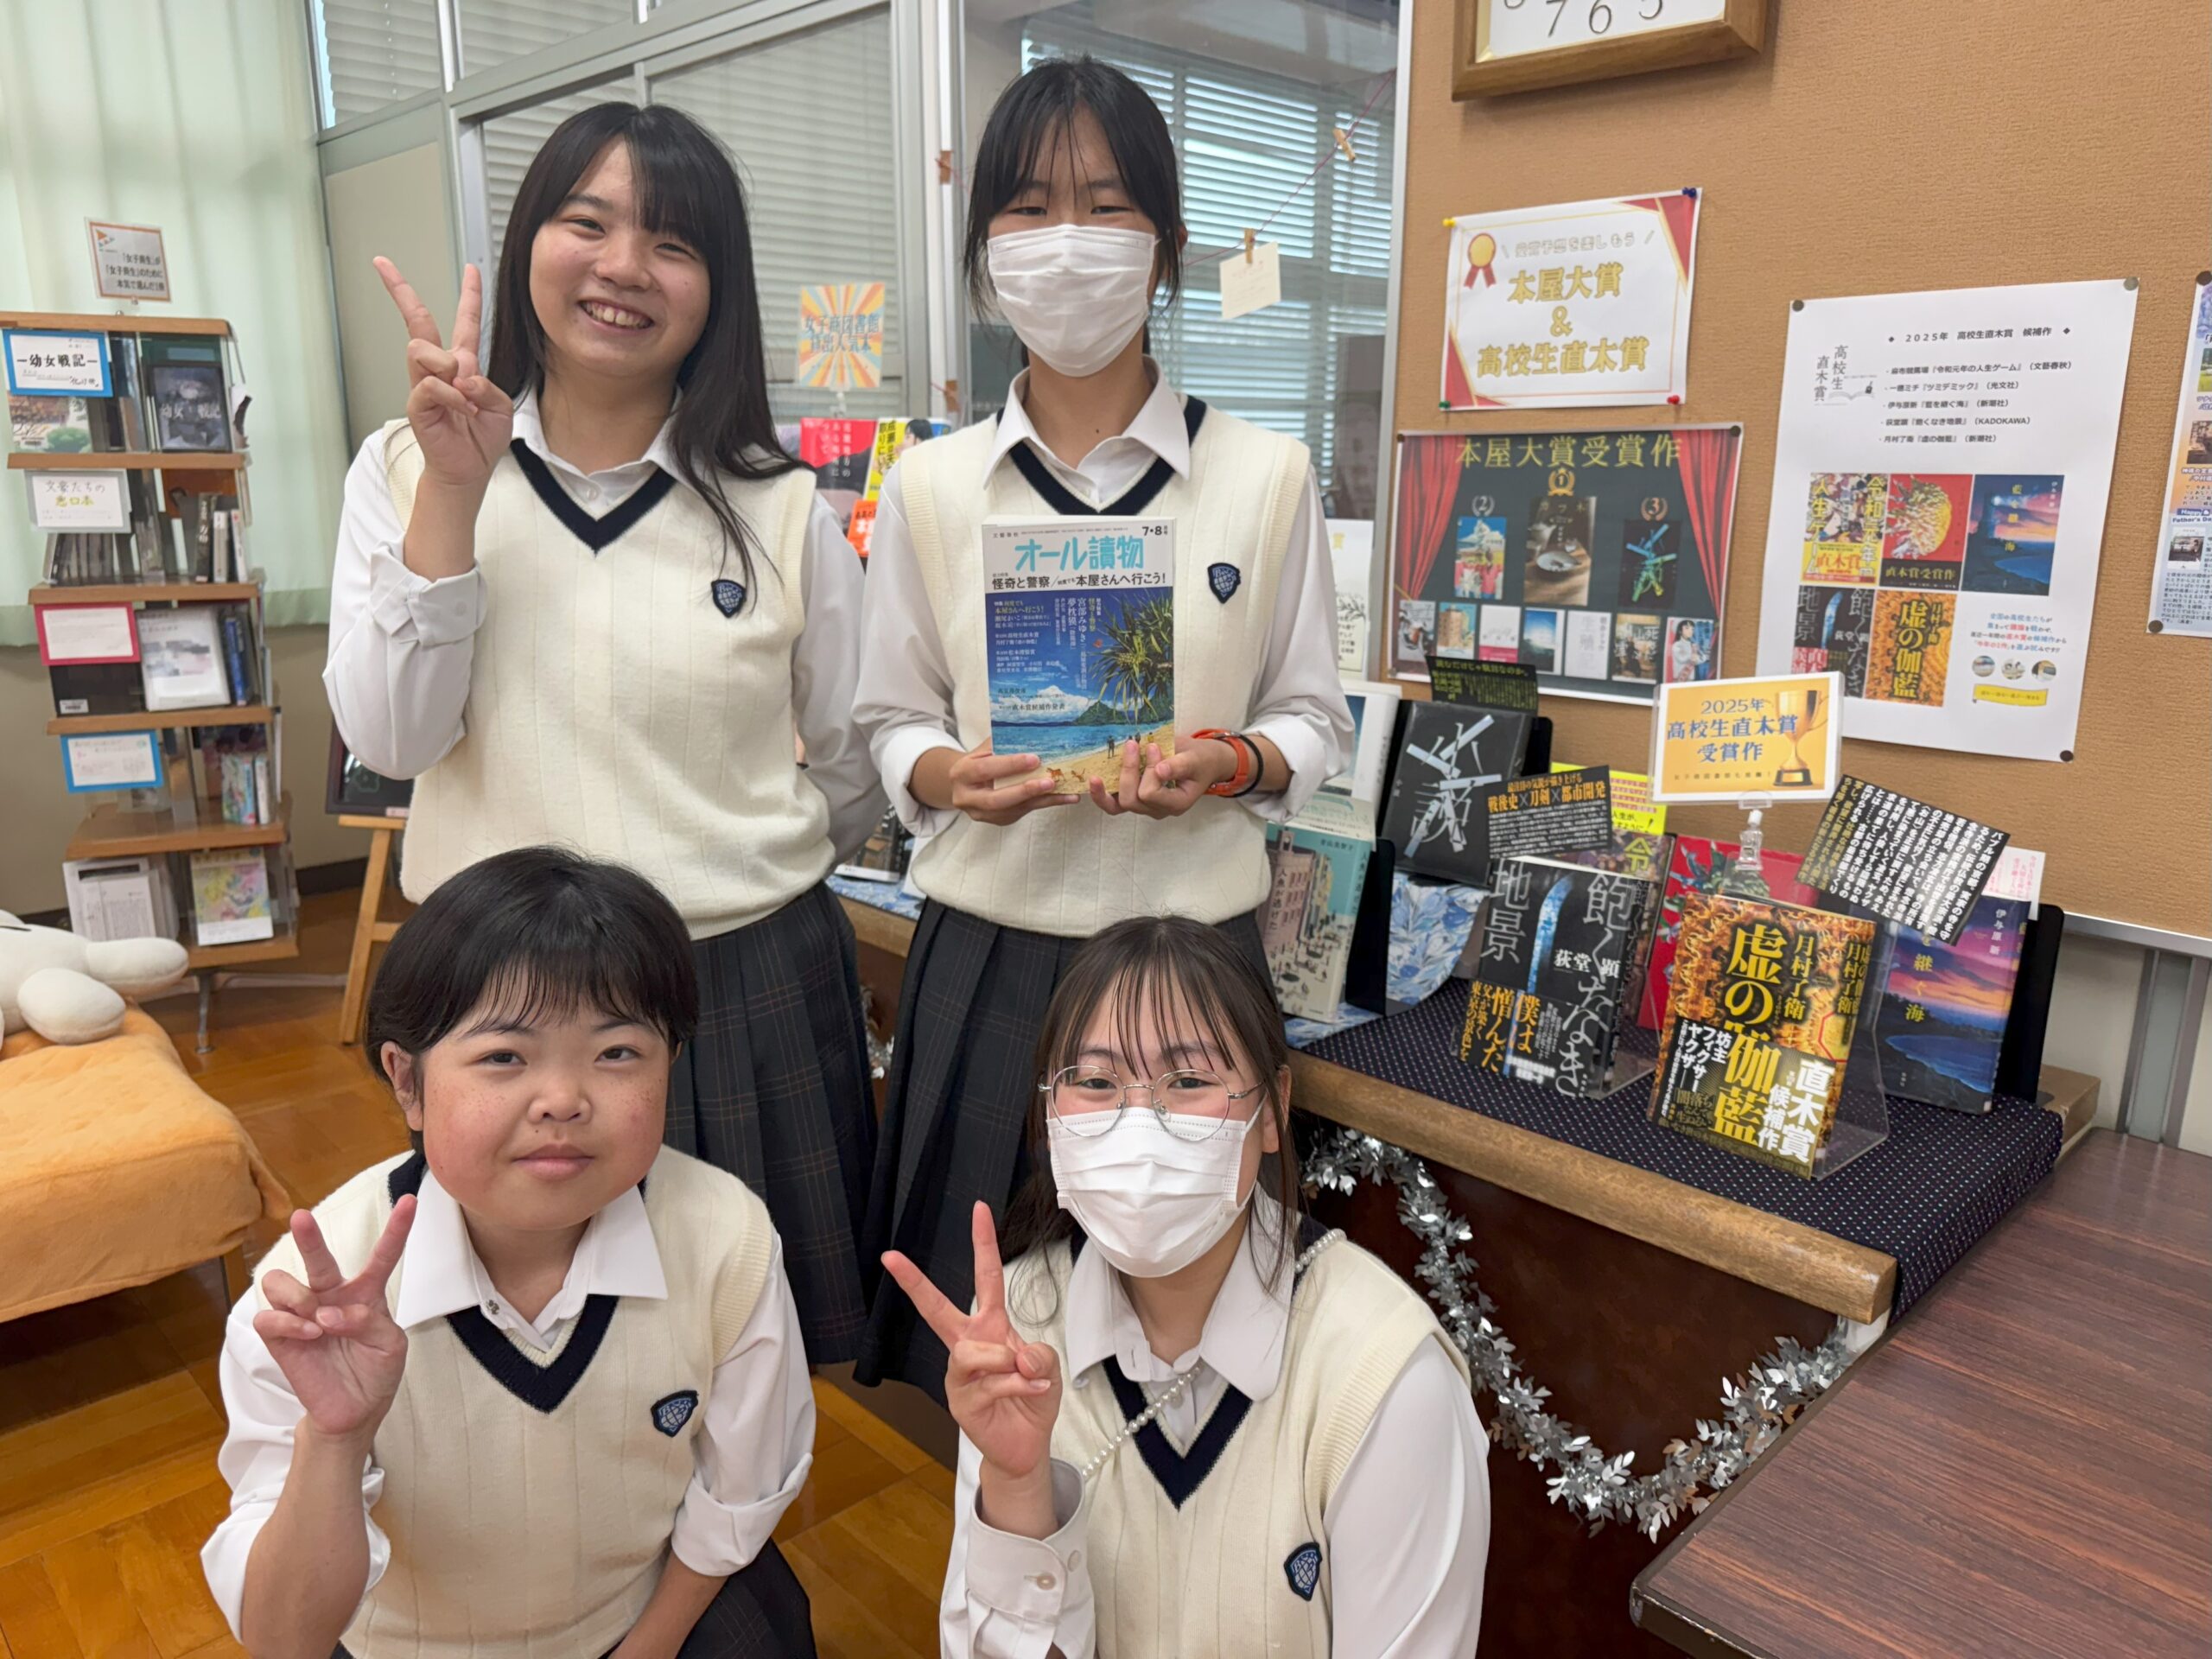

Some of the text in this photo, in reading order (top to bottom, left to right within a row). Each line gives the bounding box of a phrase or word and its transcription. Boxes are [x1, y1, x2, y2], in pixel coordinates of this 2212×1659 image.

[1546, 0, 1565, 37] 7
[1589, 0, 1611, 35] 6
[1507, 262, 1624, 304] 本屋大賞
[1549, 306, 1573, 338] &
[1905, 327, 2052, 342] 2025年 高校生直木賞 候補作
[1476, 335, 1650, 378] 高校生直木賞
[1814, 355, 1831, 402] 直木賞
[1831, 345, 1848, 391] 高校生
[1455, 433, 1683, 468] 本屋大賞受賞作
[1478, 495, 1488, 512] 2
[1649, 498, 1659, 512] 3
[1014, 535, 1144, 573] オール讀物
[1885, 566, 1956, 581] 直木賞受賞作
[1077, 597, 1087, 642] 宮部みゆき
[1891, 600, 1929, 698] 虚の伽藍
[1667, 714, 1798, 741] 高校生直木賞
[1700, 697, 1764, 715] 2025年
[1697, 741, 1764, 764] 受賞作
[1268, 868, 1288, 931] 人魚が逃げた
[1479, 860, 1533, 964] 地景
[1989, 908, 2007, 956] 伊与原新
[1783, 934, 1815, 1021] 月村了衛
[1837, 943, 1859, 1014] 月村了衛
[1481, 986, 1516, 1072] 憎んだ
[1514, 994, 1542, 1054] 僕は
[1707, 923, 1789, 1147] 虚の伽藍
[1692, 1026, 1718, 1093] フィクサー
[1713, 1028, 1733, 1065] 坊主
[1758, 1084, 1792, 1151] 候補作
[1778, 1058, 1836, 1163] 直木賞
